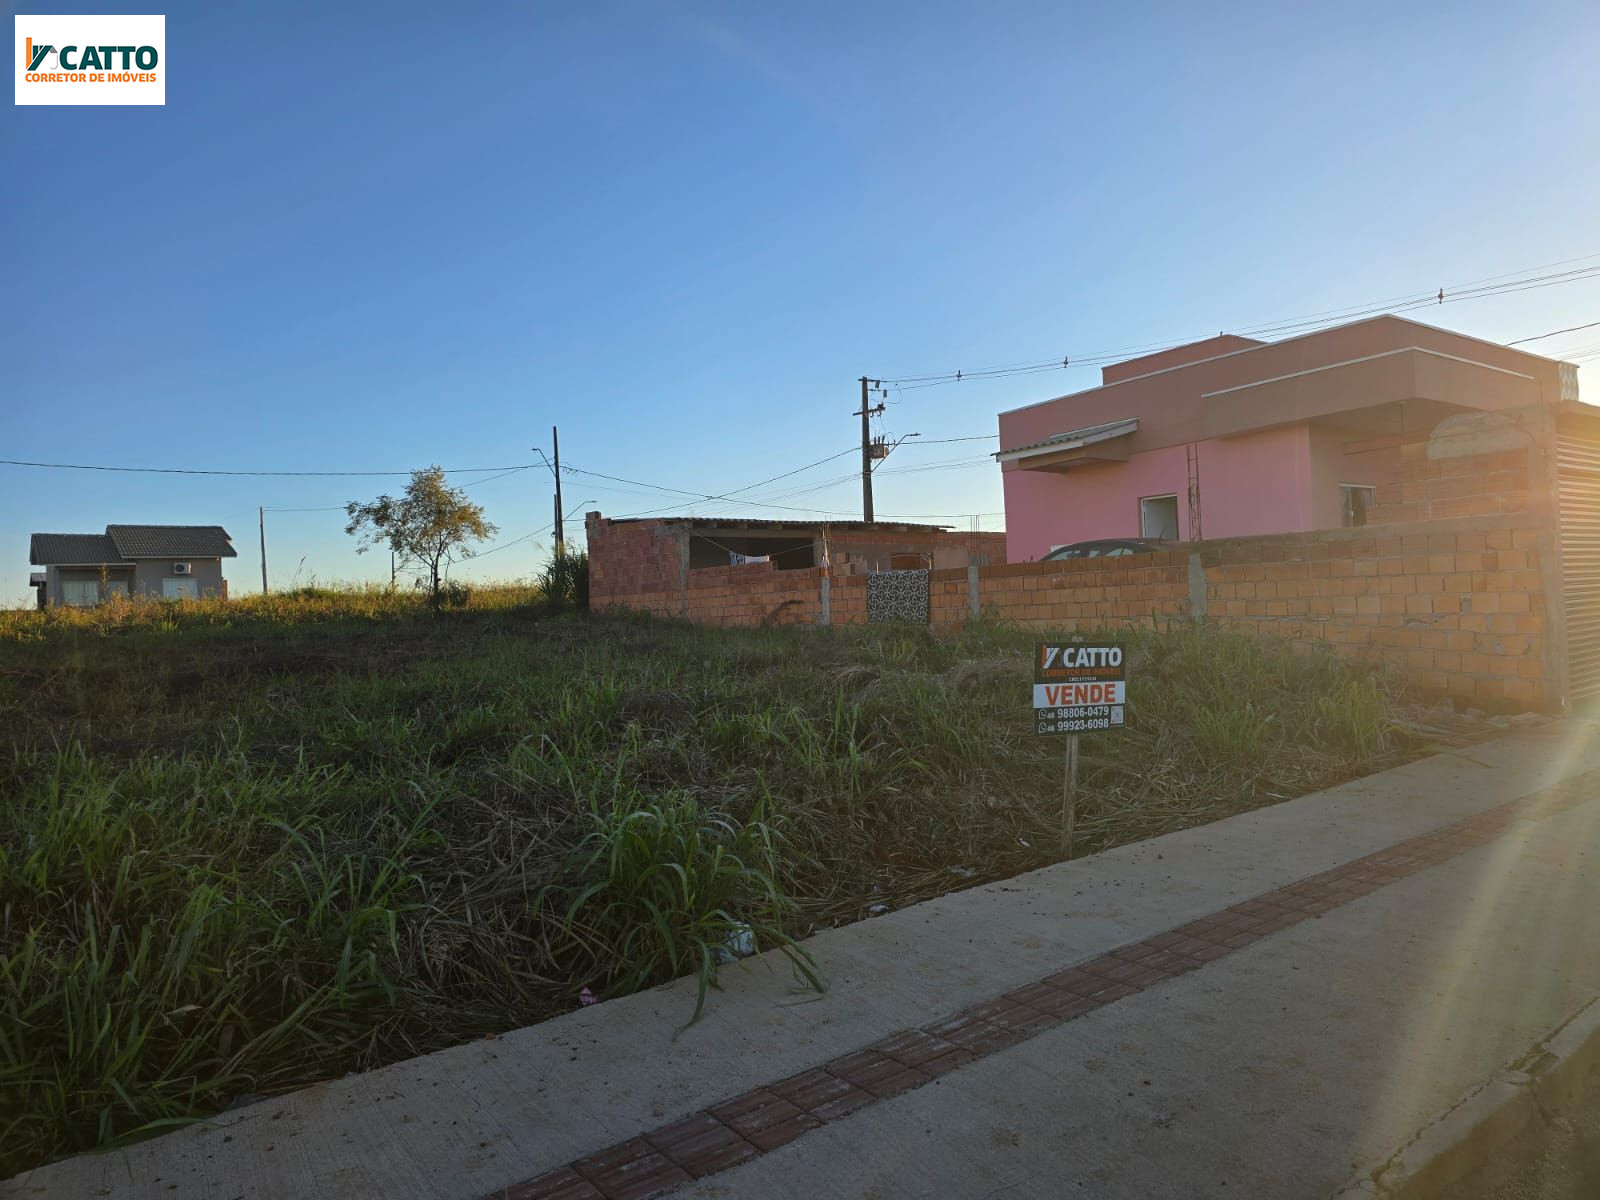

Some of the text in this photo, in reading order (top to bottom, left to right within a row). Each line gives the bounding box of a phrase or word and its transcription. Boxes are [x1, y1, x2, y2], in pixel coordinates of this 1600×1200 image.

[1063, 647, 1122, 668] CATTO
[1045, 684, 1116, 706] VENDE
[1057, 706, 1109, 719] 98806-0479
[1057, 718, 1109, 732] 99923-6098
